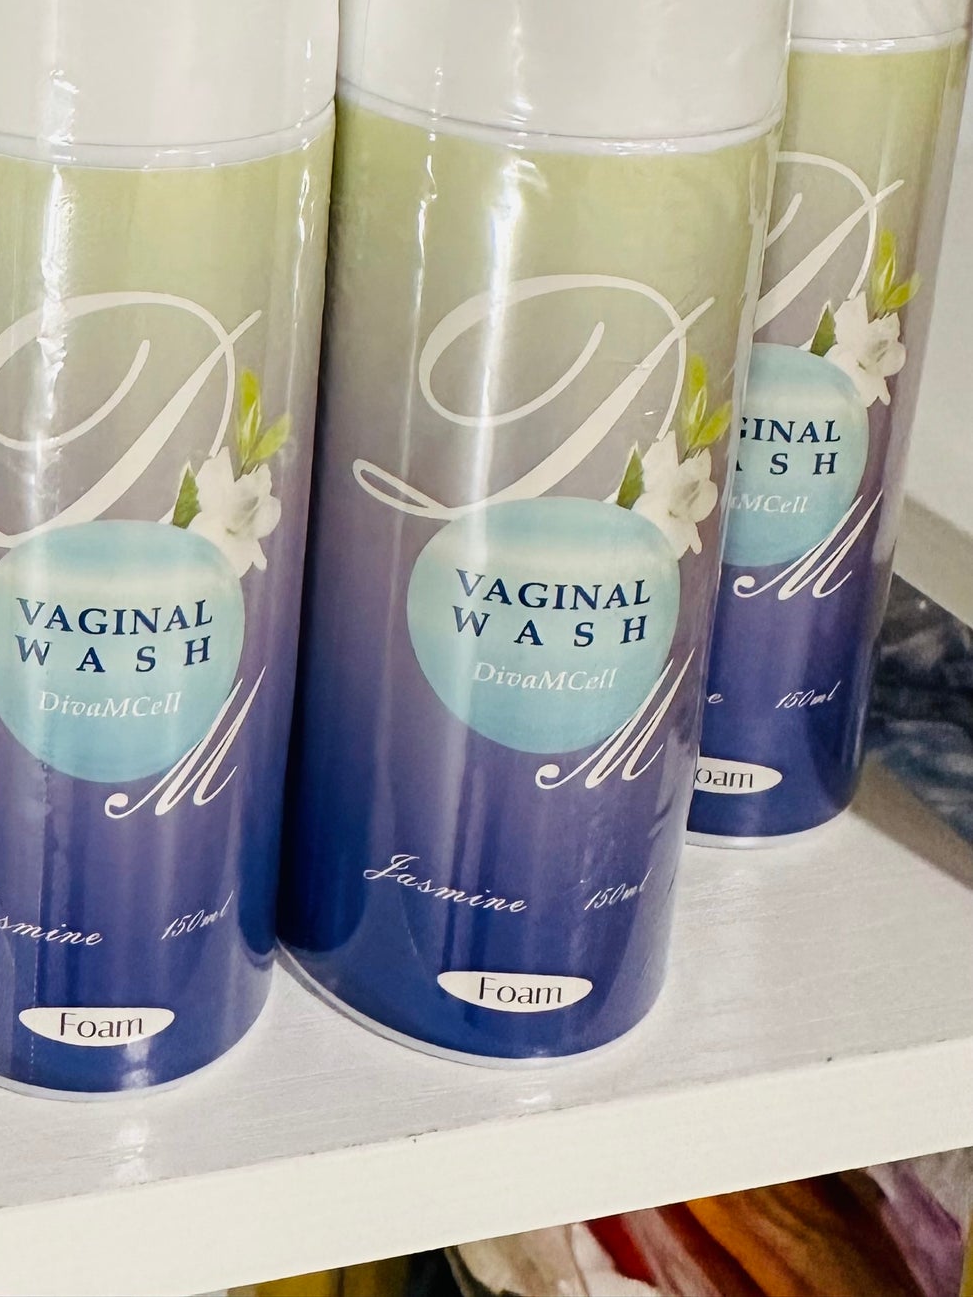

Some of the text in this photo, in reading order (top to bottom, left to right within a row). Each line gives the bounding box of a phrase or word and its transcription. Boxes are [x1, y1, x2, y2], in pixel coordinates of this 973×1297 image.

[739, 416, 841, 443] INAL
[456, 569, 651, 610] VAGINAL
[16, 598, 213, 635] VAGINAL
[452, 605, 648, 647] WASH
[15, 635, 211, 673] WASH
[473, 662, 617, 691] DivaMCell
[775, 680, 841, 709] 150ml
[38, 691, 182, 718] DivaMCell
[535, 647, 696, 790] M
[104, 666, 266, 819] M
[695, 768, 753, 788] oam
[363, 854, 527, 913] Jasmine
[584, 867, 653, 911] 150ml
[161, 890, 234, 941] 150ml
[478, 976, 562, 1005] Foam
[60, 1012, 144, 1038] Foam
